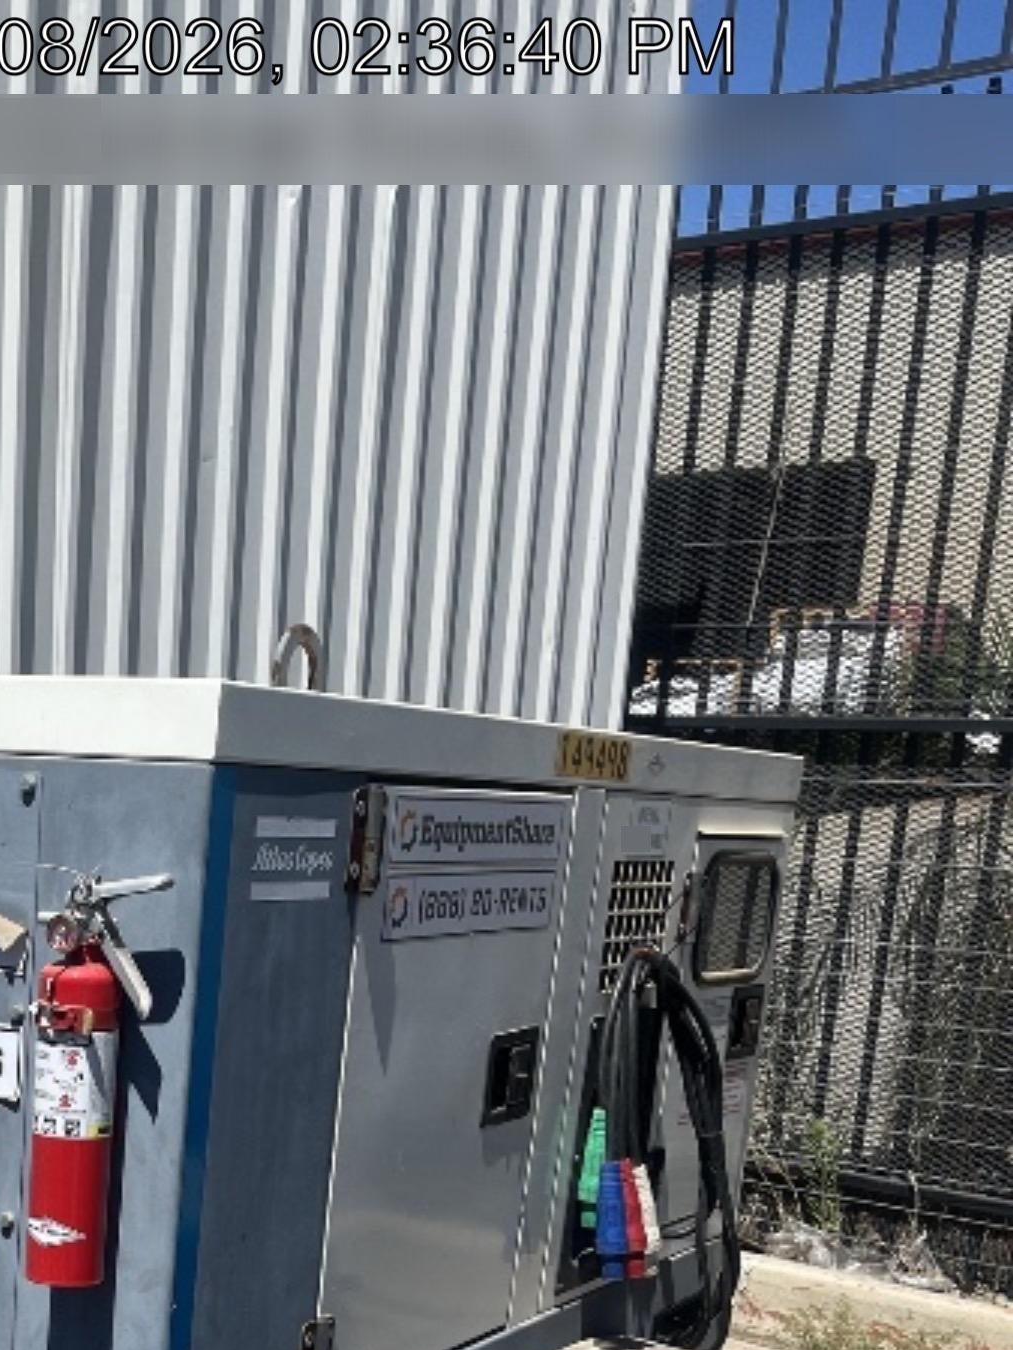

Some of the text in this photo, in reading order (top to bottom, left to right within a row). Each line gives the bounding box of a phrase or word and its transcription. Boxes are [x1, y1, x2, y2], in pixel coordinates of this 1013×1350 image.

[560, 735, 630, 781] 149498
[418, 813, 555, 853] EquipmentShare
[251, 842, 294, 873] Atlas
[419, 886, 547, 924] (888) 80-RENTS
